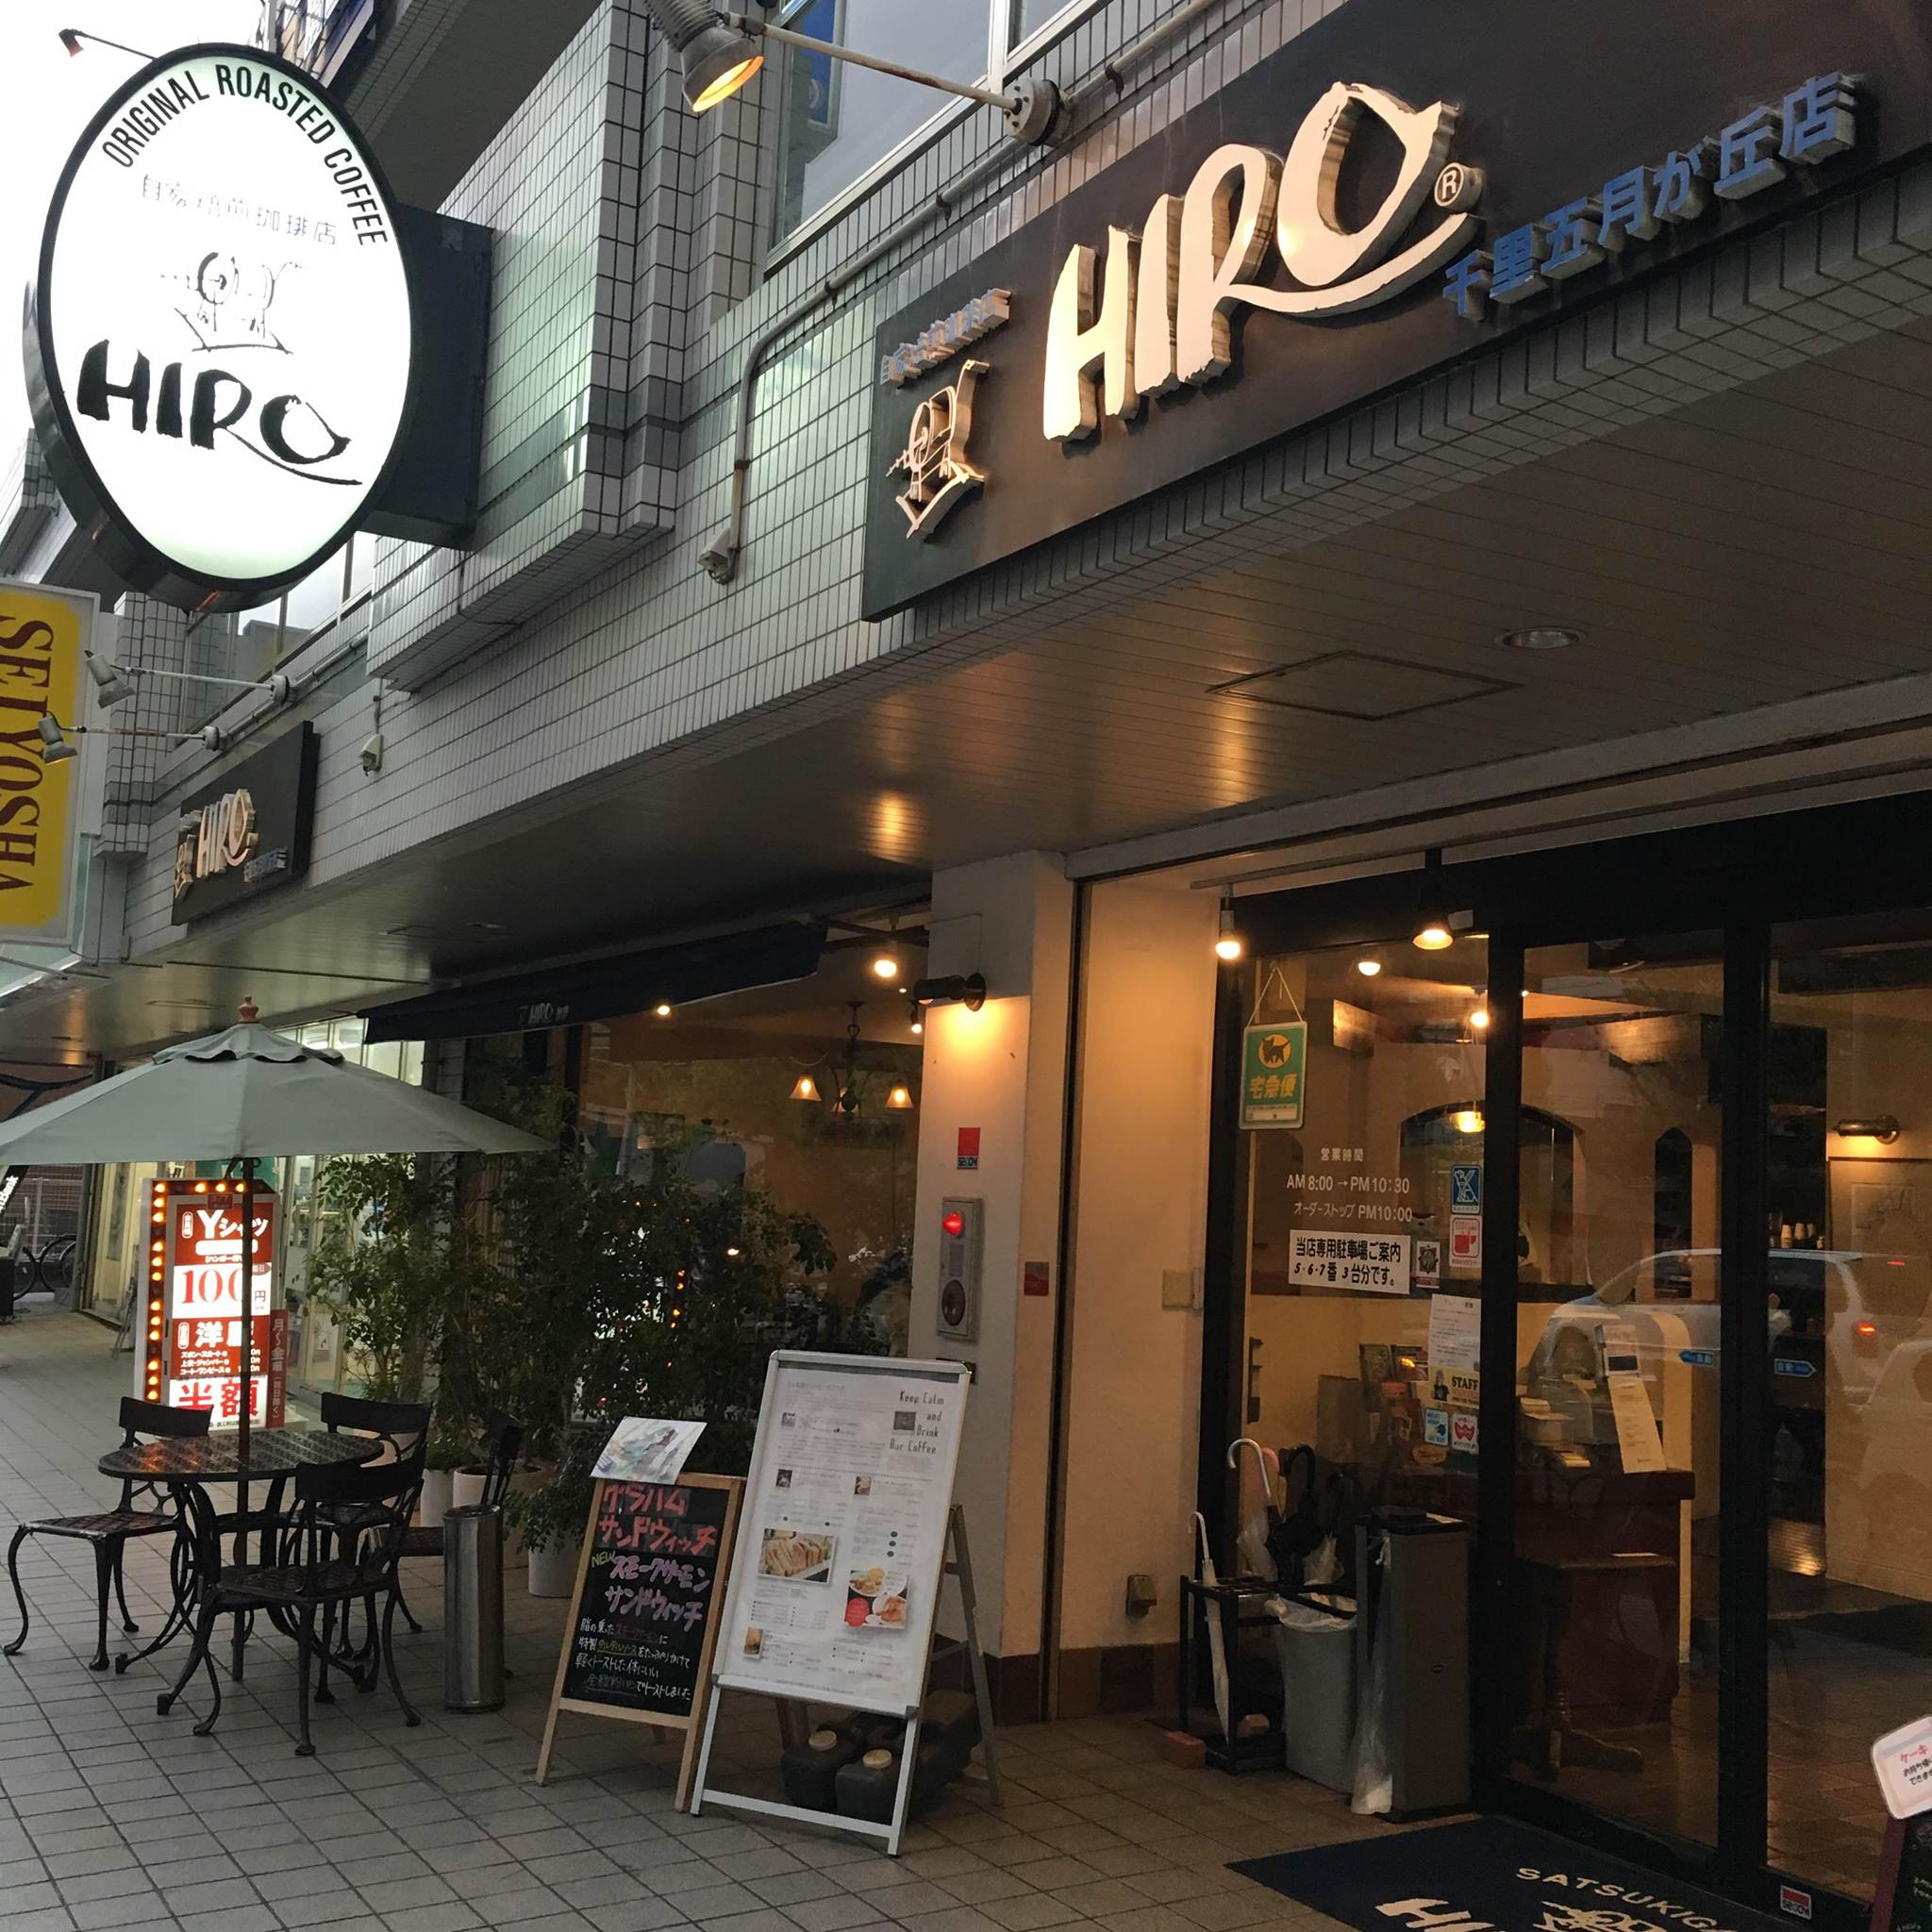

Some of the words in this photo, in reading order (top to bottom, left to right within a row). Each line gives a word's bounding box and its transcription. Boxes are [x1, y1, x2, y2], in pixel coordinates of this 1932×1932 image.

[102, 71, 210, 168] ORIGINAL
[215, 64, 336, 143] ROASTED
[324, 148, 388, 245] COFFEE
[1442, 72, 1844, 317] 千里五月が丘店
[1043, 81, 1483, 443] HIRO
[76, 339, 363, 486] HIRO
[196, 788, 256, 878] HIRO
[1250, 1073, 1298, 1100] 宅急便
[1321, 1147, 1364, 1162] 営業時間
[1287, 1174, 1306, 1190] AM
[1307, 1175, 1334, 1191] 8:00
[1350, 1176, 1371, 1192] PM
[1372, 1177, 1410, 1194] 10:30
[1293, 1201, 1357, 1219] オーダーストップ
[1296, 1237, 1402, 1263] 当店専用駐車場ご案内
[1452, 1376, 1479, 1391] STAFF
[899, 1391, 919, 1404] Keep
[923, 1392, 944, 1405] Calm
[926, 1411, 942, 1421] and
[916, 1425, 939, 1438] Drink
[908, 1440, 937, 1455] Coffee
[604, 1483, 685, 1516] グラハム
[598, 1514, 717, 1556] サンドウィッチ
[591, 1550, 616, 1568] NEW
[1900, 1744, 1929, 1764] ケーキ
